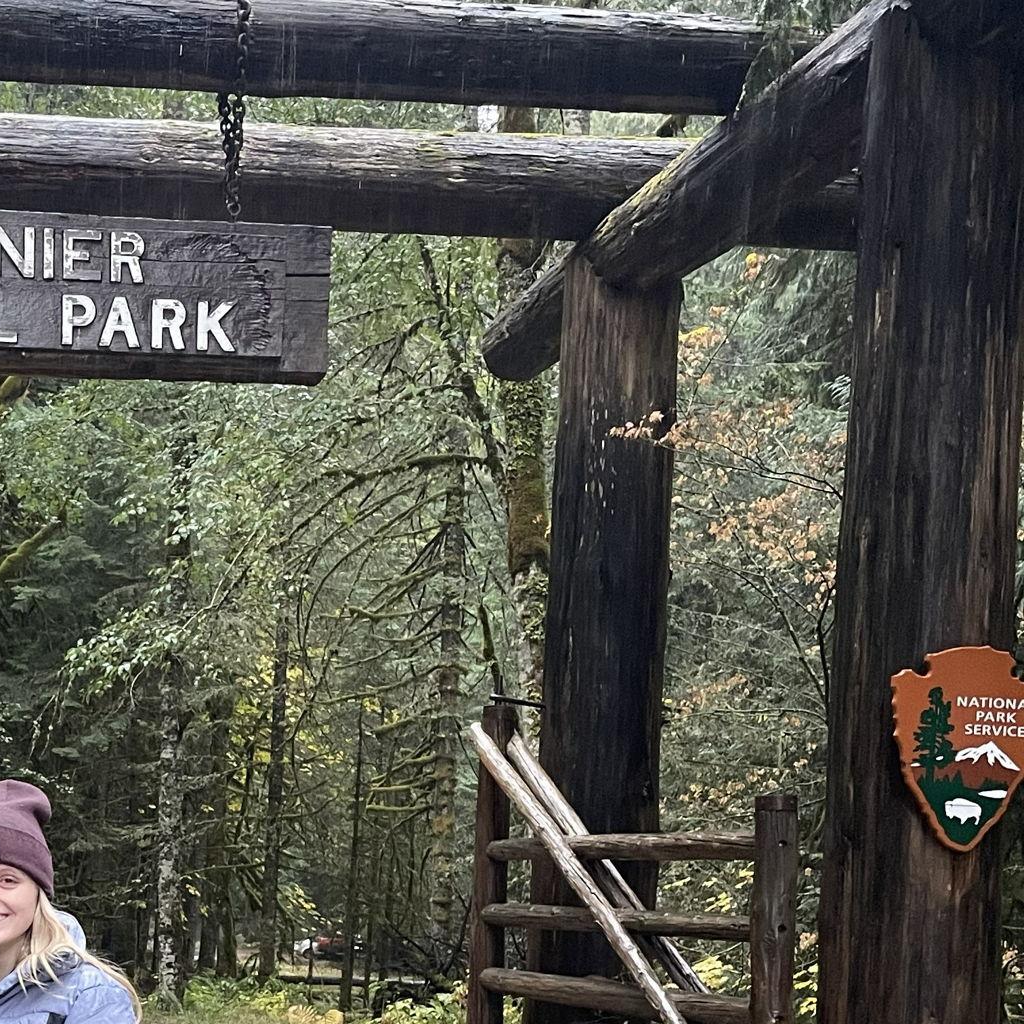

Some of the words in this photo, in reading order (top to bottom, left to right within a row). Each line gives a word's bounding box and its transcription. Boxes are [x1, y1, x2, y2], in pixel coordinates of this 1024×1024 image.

[61, 294, 237, 352] PARK
[976, 710, 1017, 723] PARK
[964, 723, 1024, 738] SERVICE
